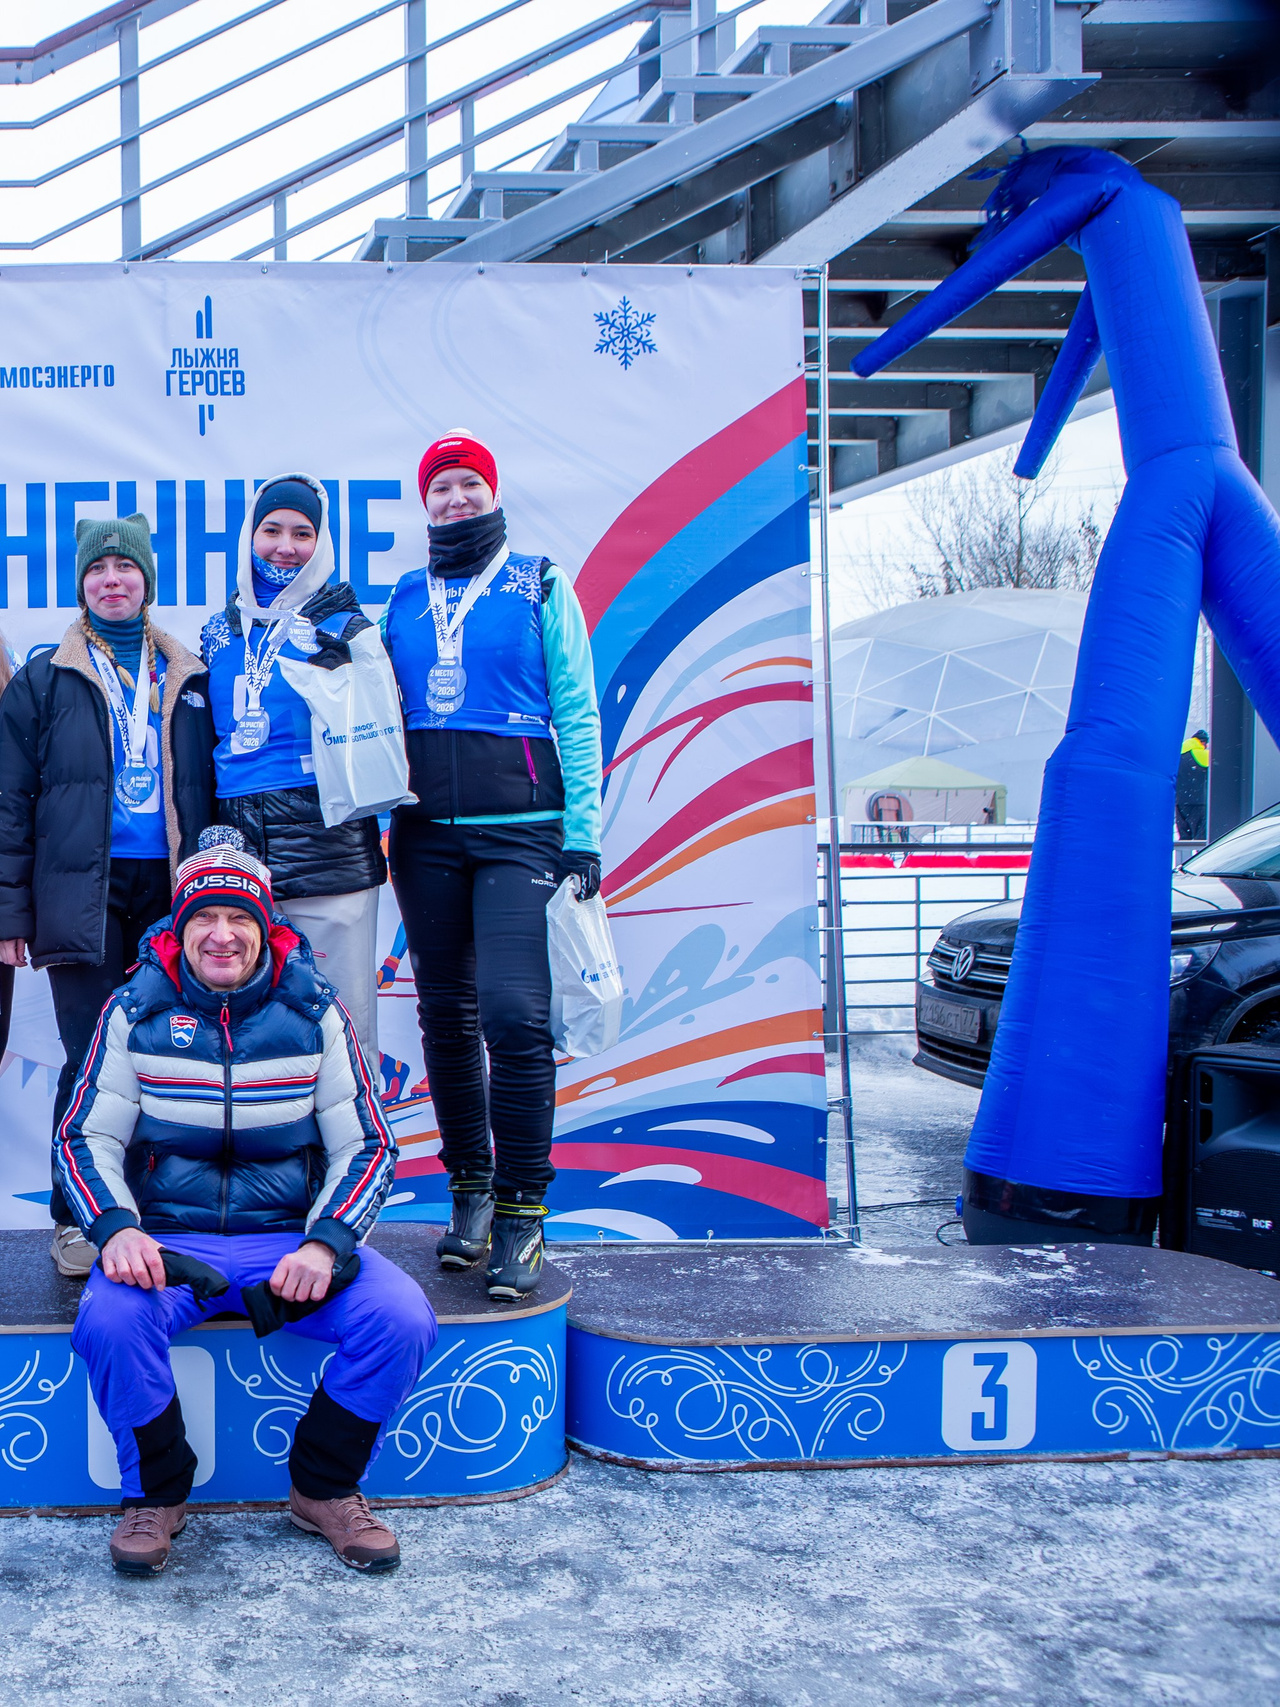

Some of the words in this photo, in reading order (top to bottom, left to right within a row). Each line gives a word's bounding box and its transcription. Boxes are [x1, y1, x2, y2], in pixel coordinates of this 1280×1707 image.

[170, 346, 240, 369] ЛЫЖНЯ
[0, 364, 115, 389] МОСЭНЕРГО
[164, 369, 246, 397] ГЕРОЕВ
[446, 586, 491, 600] ЛЫЯ
[435, 669, 454, 677] МЕСТО
[437, 686, 456, 696] 2026
[436, 702, 454, 713] 2026
[242, 737, 260, 747] 2026
[1251, 1218, 1273, 1230] RCF
[970, 1351, 1010, 1442] 3
